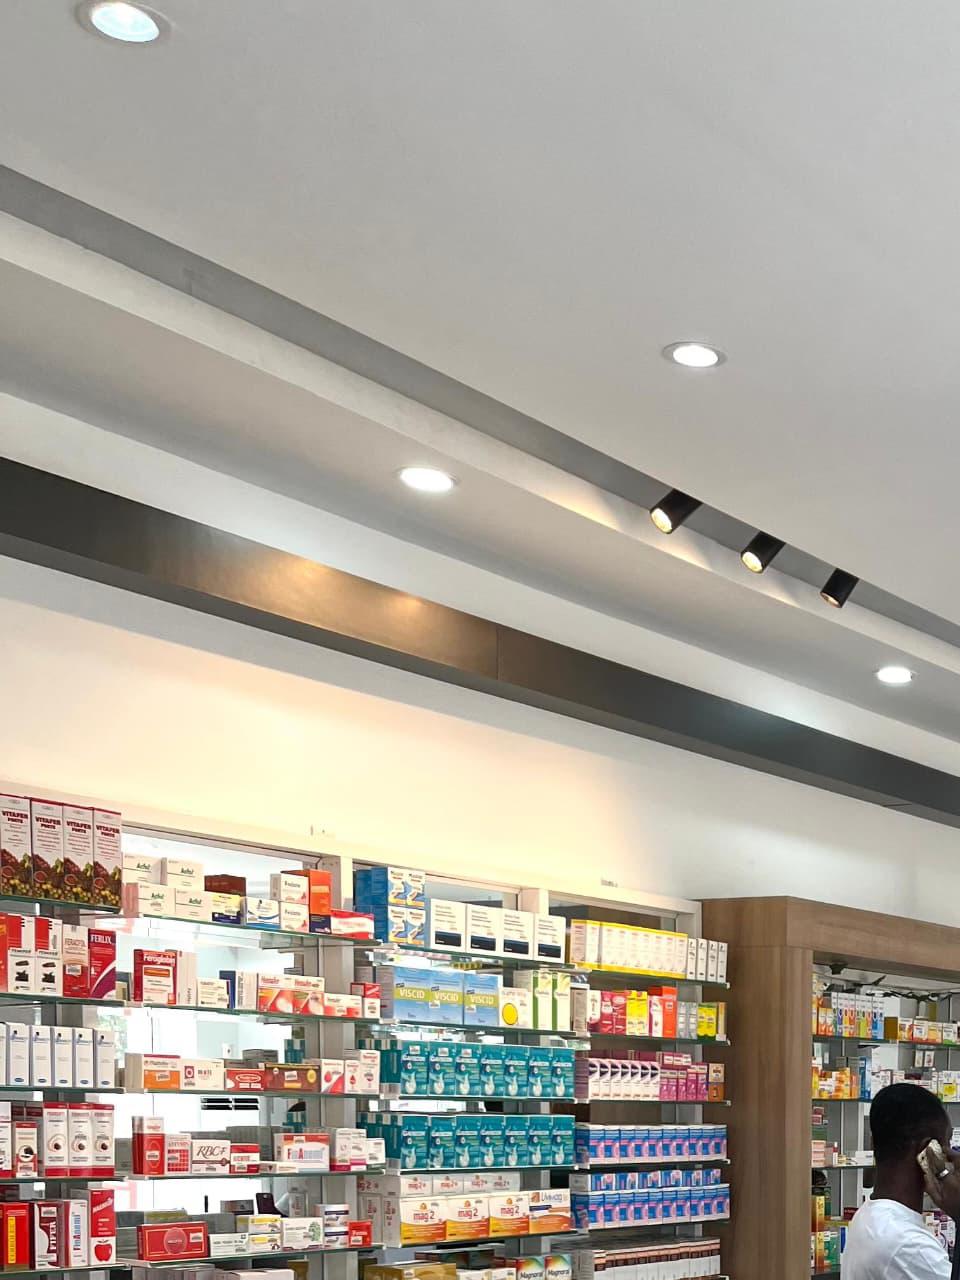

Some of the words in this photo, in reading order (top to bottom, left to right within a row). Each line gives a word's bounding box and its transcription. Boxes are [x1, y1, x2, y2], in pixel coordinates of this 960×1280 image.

[2, 811, 28, 819] VITAFER
[35, 816, 61, 825] VITAFER
[66, 820, 91, 830] VITAFER
[96, 825, 120, 834] VITAFER
[400, 989, 425, 999] VISCID
[435, 992, 459, 1001] VISCID
[471, 995, 494, 1004] VISCID
[458, 1210, 472, 1219] mag
[473, 1208, 478, 1217] 2
[501, 1207, 514, 1216] mag
[515, 1206, 520, 1214] 2
[413, 1212, 429, 1222] mag
[430, 1211, 435, 1219] 2
